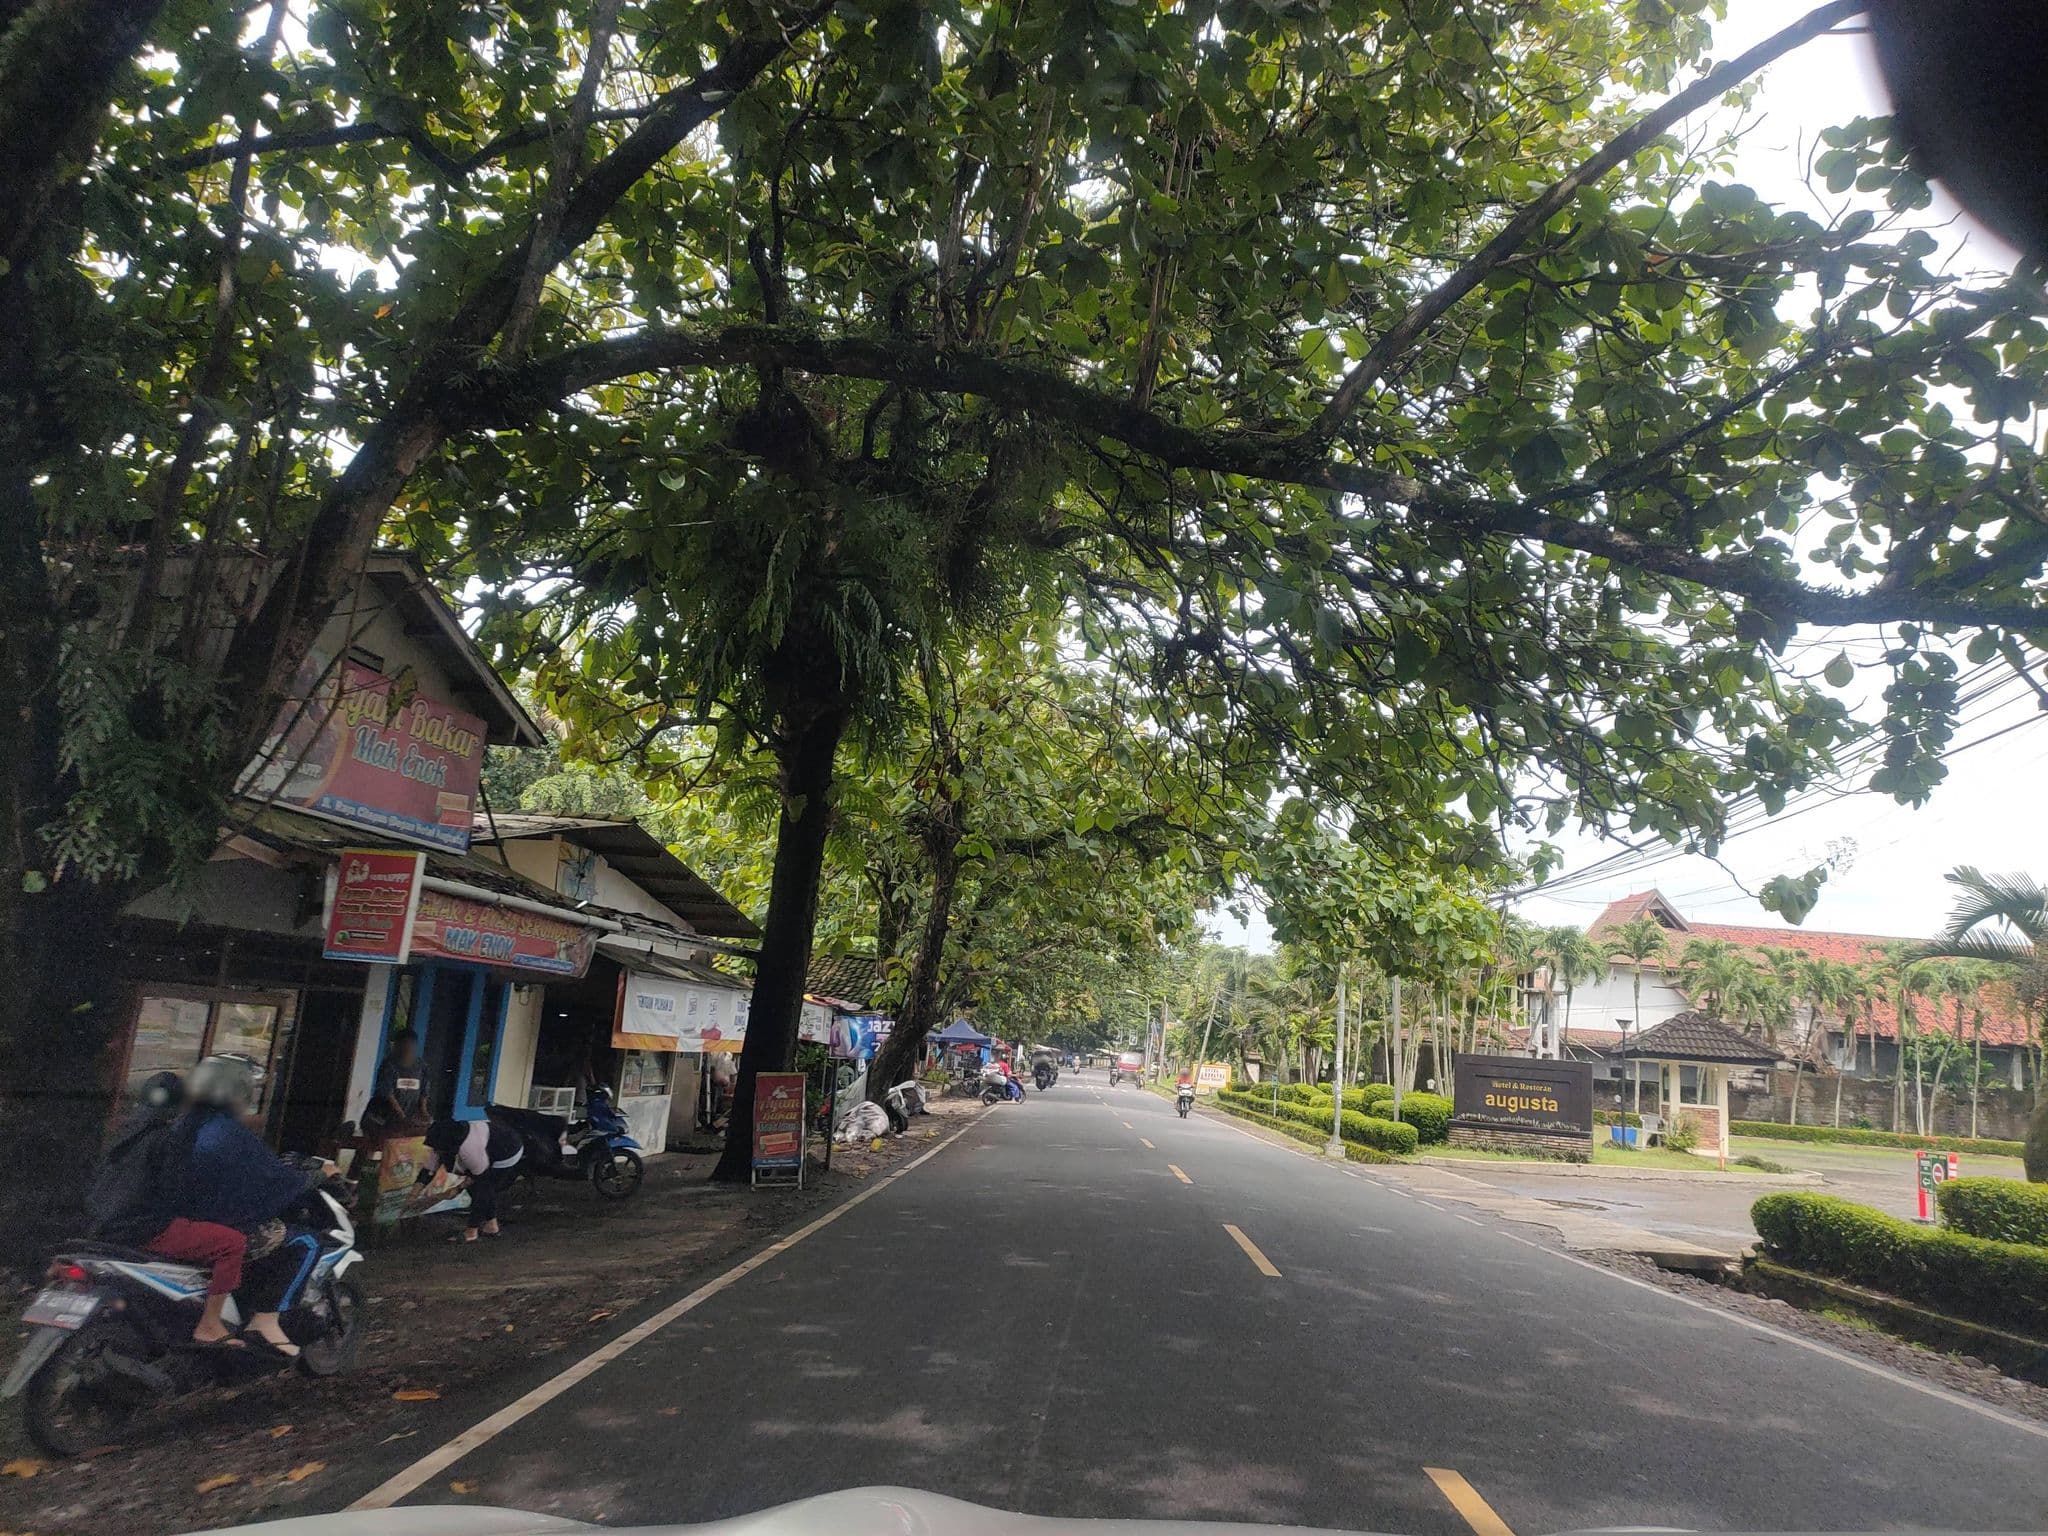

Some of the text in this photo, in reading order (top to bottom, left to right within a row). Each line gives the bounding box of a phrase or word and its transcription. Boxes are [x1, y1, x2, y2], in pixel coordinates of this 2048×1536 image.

[408, 699, 480, 760] Bakar
[352, 725, 401, 772] Mak
[401, 743, 449, 788] Enok
[444, 926, 517, 961] MAK ENOK
[1485, 1093, 1559, 1113] augusta
[1491, 1081, 1552, 1093] Hotel & Restoran
